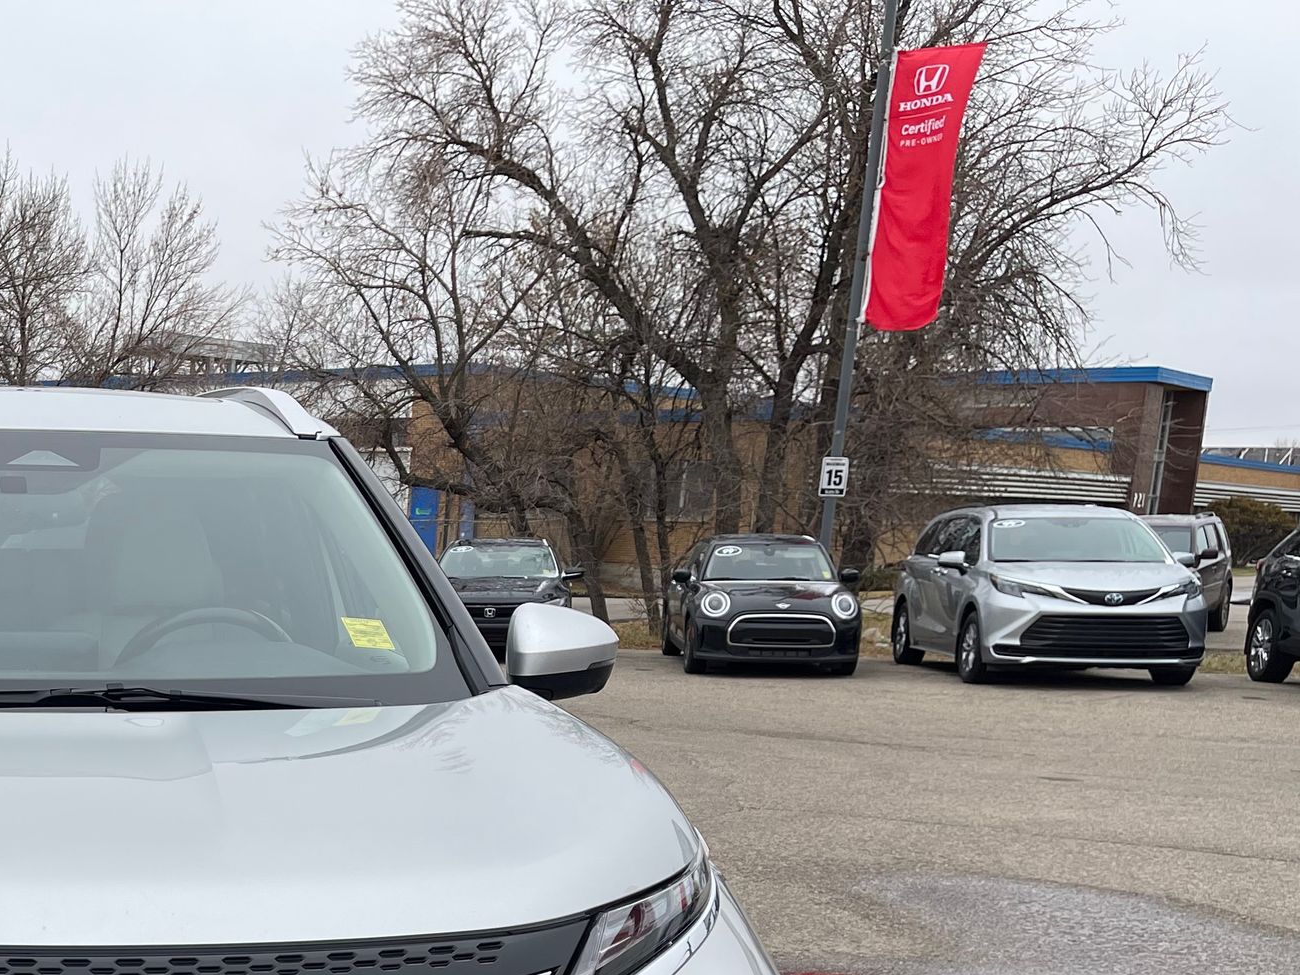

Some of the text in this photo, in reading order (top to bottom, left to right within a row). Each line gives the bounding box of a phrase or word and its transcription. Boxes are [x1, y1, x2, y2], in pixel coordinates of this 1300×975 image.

[898, 93, 954, 112] HONDA
[901, 115, 946, 135] Certified
[826, 469, 843, 486] 15
